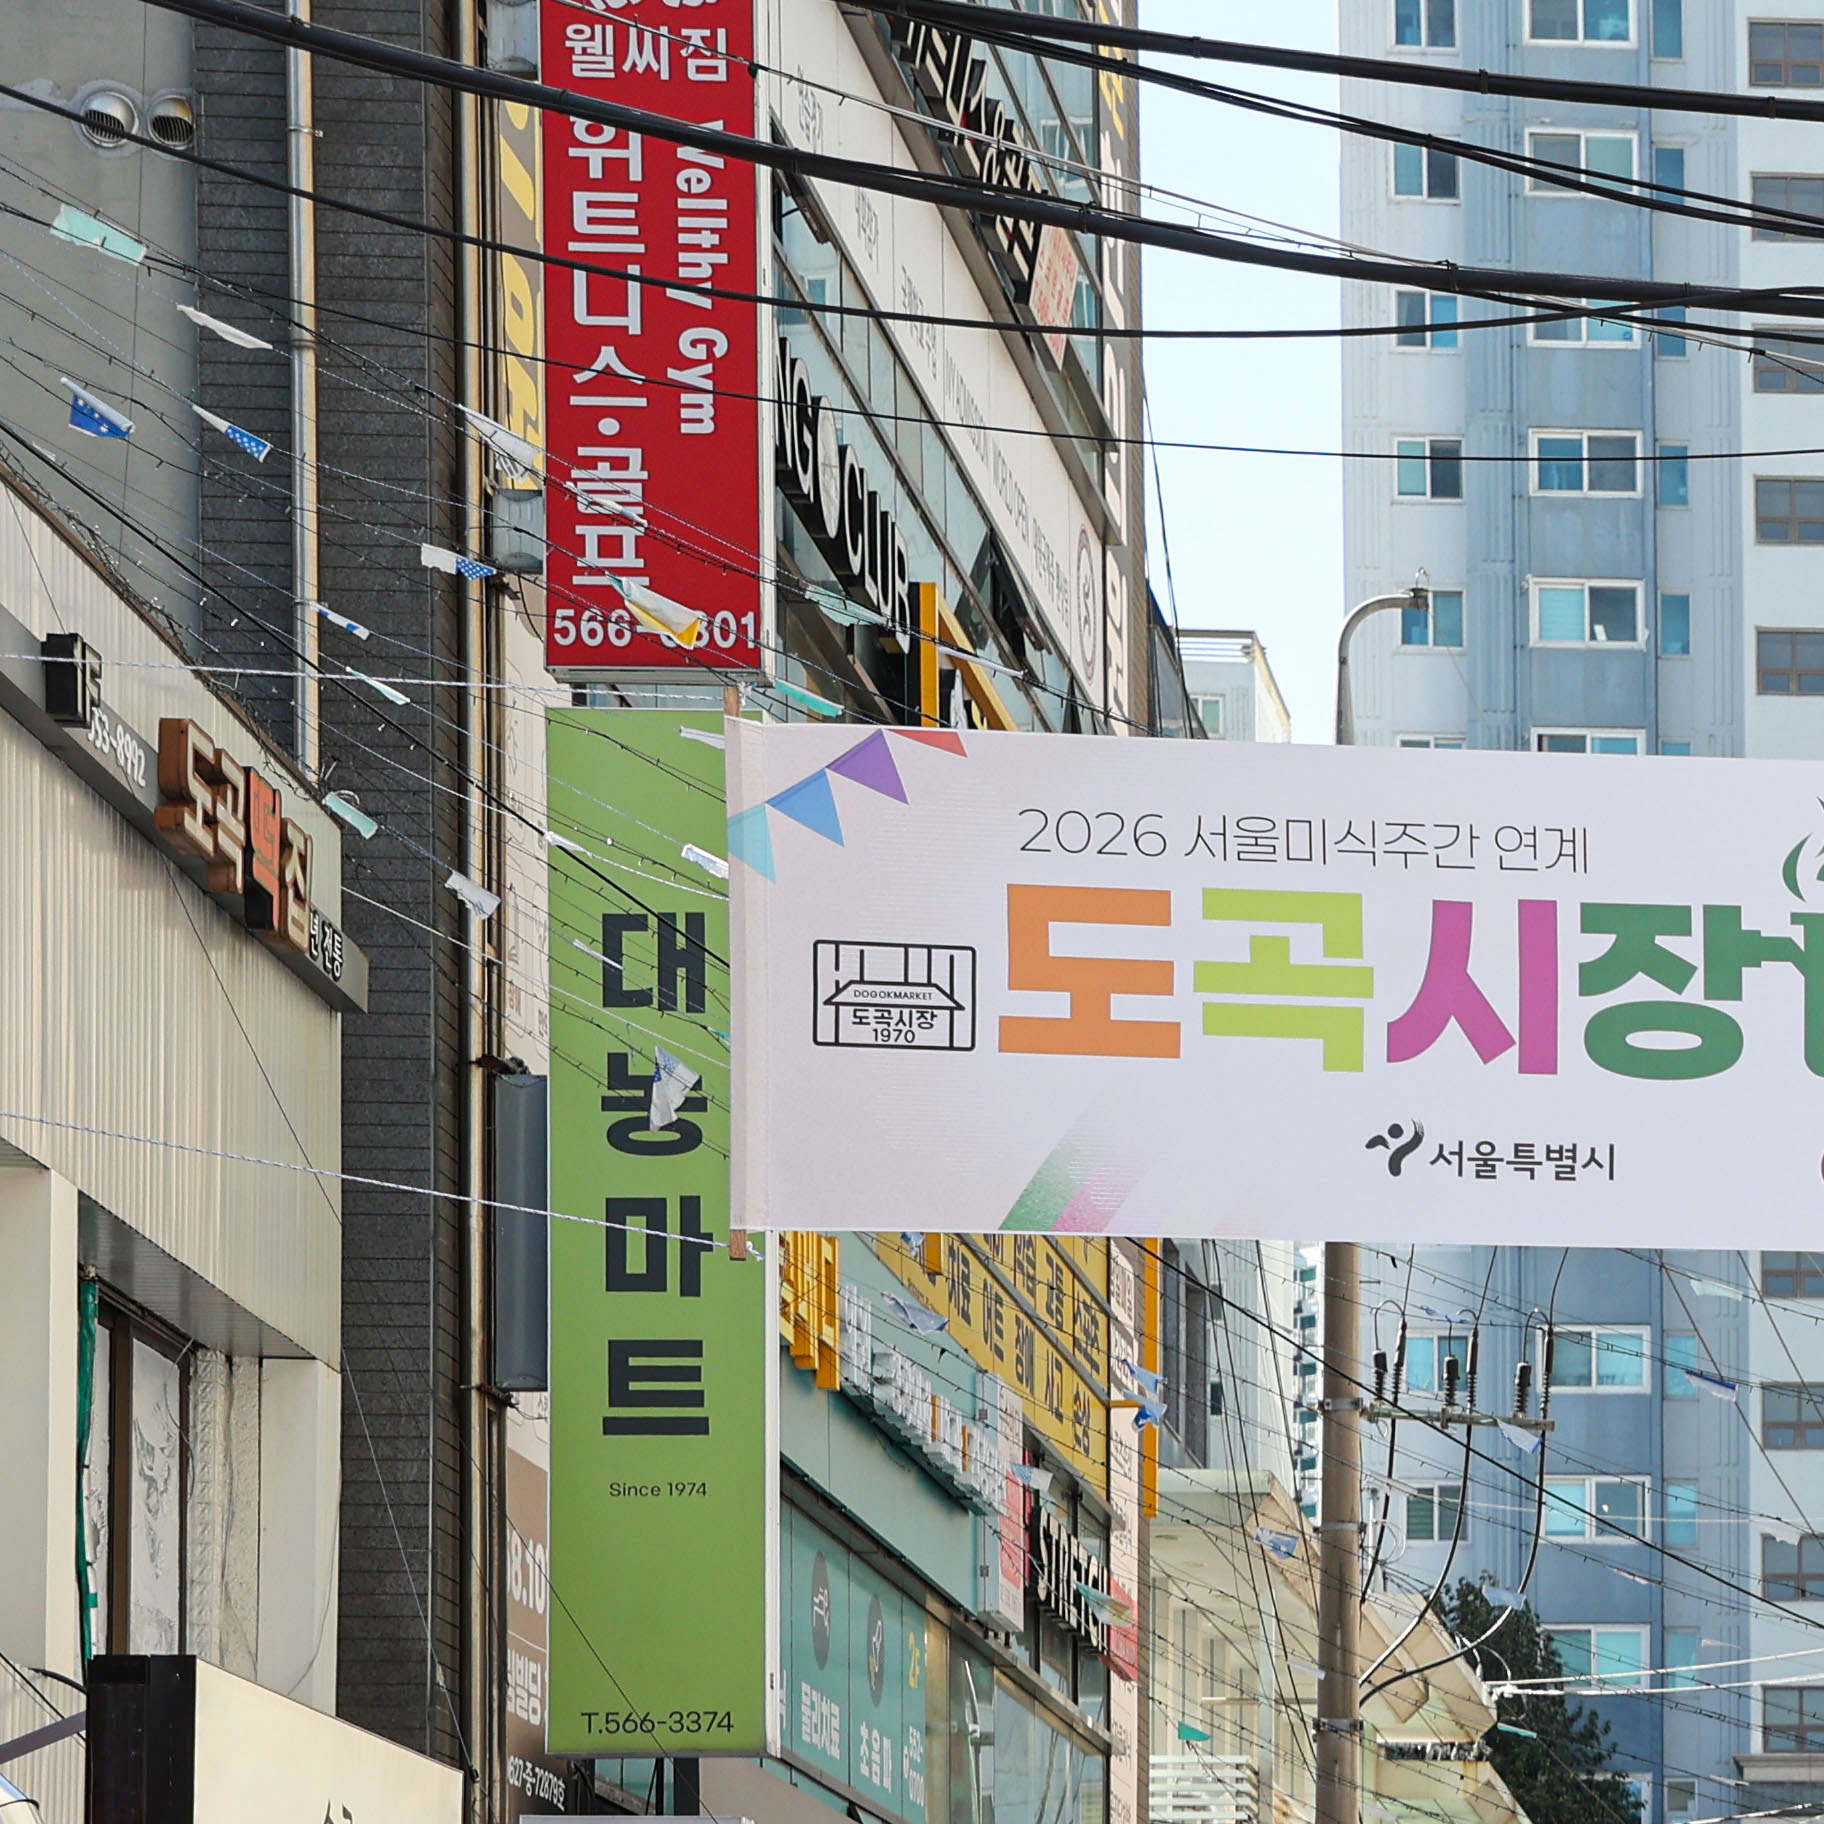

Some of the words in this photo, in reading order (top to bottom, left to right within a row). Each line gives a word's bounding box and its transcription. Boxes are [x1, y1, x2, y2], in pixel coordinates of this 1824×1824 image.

[565, 23, 728, 82] 웰씨짐
[667, 326, 729, 435] Gym
[552, 607, 757, 650] 566-01
[1017, 808, 1168, 858] 2026
[1184, 813, 1478, 871] 서울미식주간
[1493, 822, 1590, 875] 연계
[853, 988, 933, 1003] DOGOKMARKET
[998, 883, 1746, 1081] 도곡시장
[851, 1007, 939, 1030] 도곡시장
[872, 1028, 916, 1044] 1970
[600, 911, 709, 1436] 대농마트
[1429, 1139, 1617, 1182] 서울특별시
[609, 1481, 662, 1498] Since
[668, 1482, 708, 1498] 1974
[907, 1631, 921, 1688] 2F
[581, 1710, 735, 1736] T.566-3374
[801, 1680, 841, 1760] 물리치료
[859, 1720, 892, 1793] 초음파
